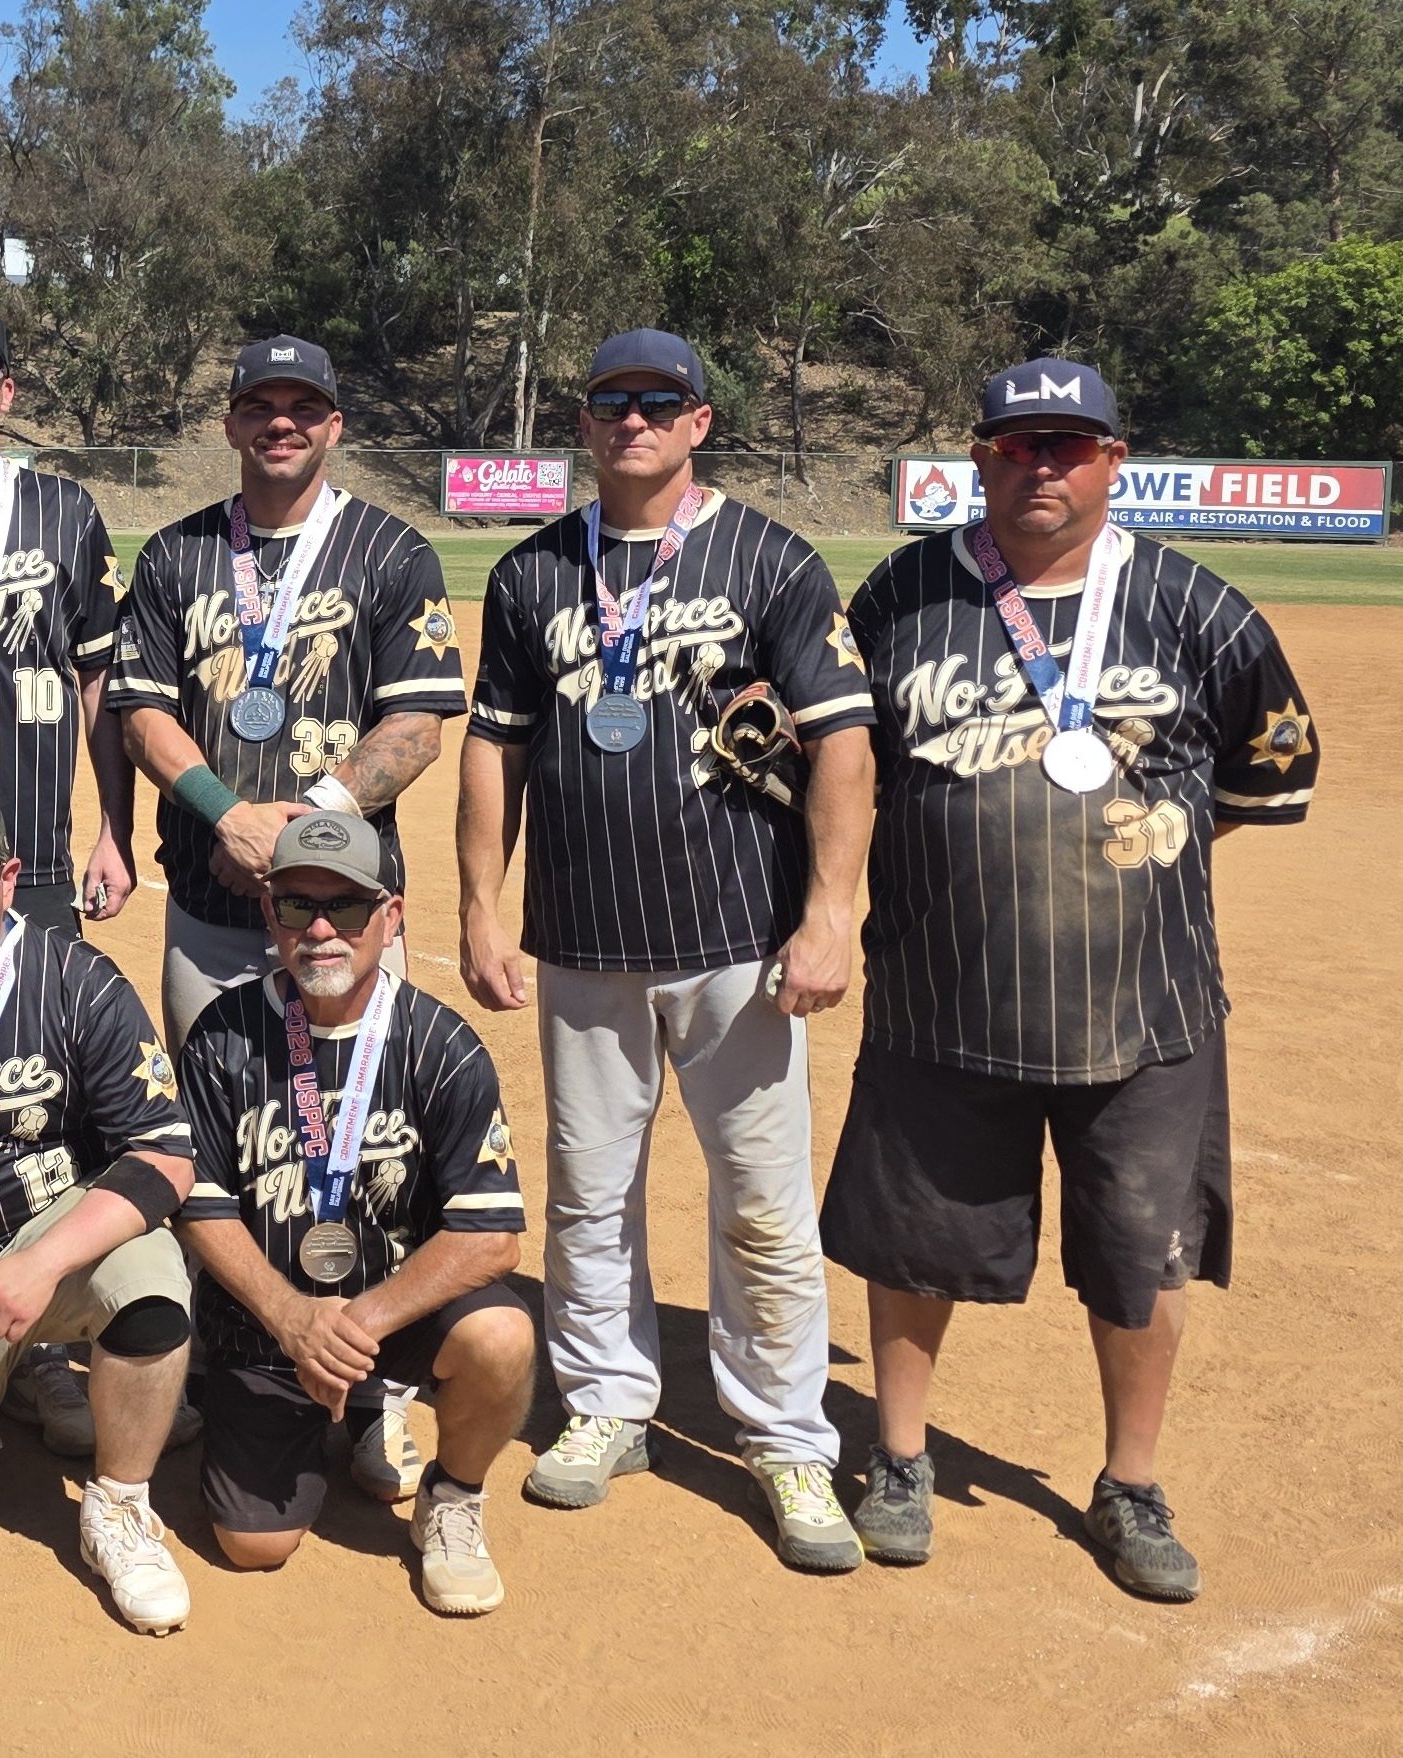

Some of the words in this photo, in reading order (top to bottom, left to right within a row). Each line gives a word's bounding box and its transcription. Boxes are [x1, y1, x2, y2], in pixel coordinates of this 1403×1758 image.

[1005, 373, 1082, 405] LM
[477, 459, 536, 492] Gelato
[1108, 471, 1193, 502] OWE
[1221, 472, 1341, 506] FIELD
[1133, 510, 1145, 522] &
[1148, 511, 1174, 523] AIR
[1190, 511, 1296, 527] RESTORATION
[1301, 514, 1313, 527] &
[1317, 515, 1371, 529] FLOOD
[184, 589, 238, 661] No
[232, 553, 263, 626] USPFC
[993, 581, 1047, 662] USPFC
[545, 602, 598, 675] No
[12, 666, 64, 725] 10
[897, 653, 988, 739] No
[289, 716, 359, 777] 33
[946, 711, 1056, 778] Use
[1102, 797, 1190, 869] 30
[285, 999, 313, 1067] 2026
[294, 1071, 329, 1158] USPFC
[340, 1099, 360, 1161] COMMITMENT
[355, 1026, 378, 1095] CAMARADERIE
[236, 1099, 297, 1175] No
[13, 1145, 81, 1215] 13
